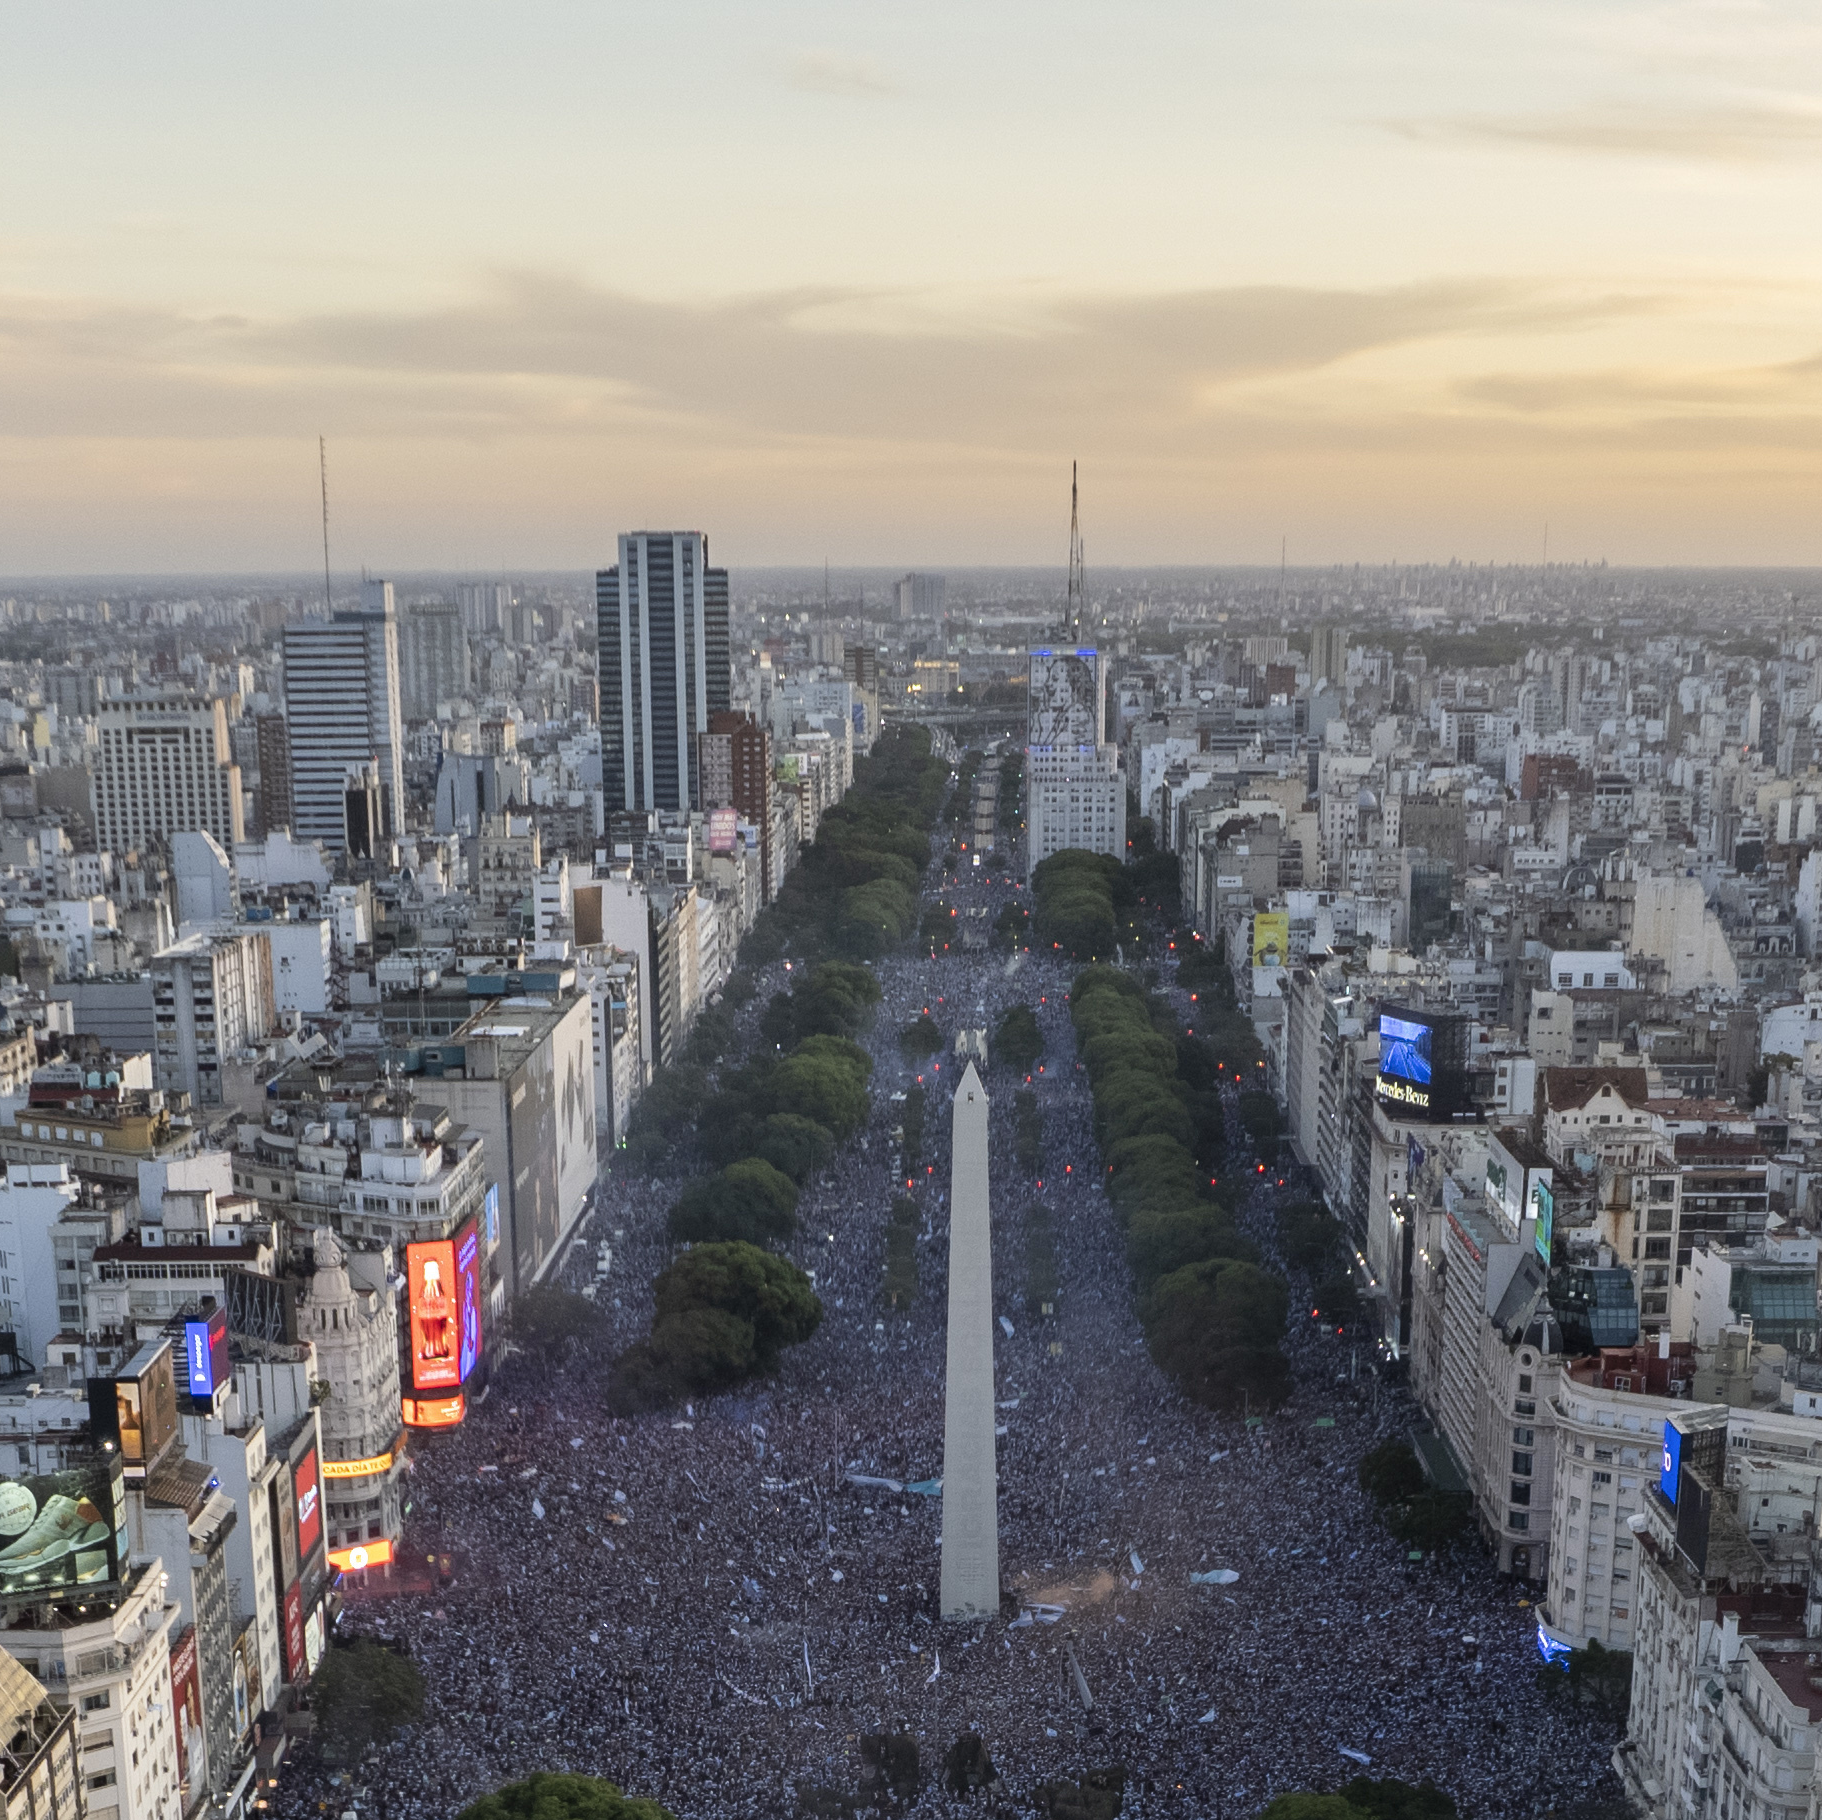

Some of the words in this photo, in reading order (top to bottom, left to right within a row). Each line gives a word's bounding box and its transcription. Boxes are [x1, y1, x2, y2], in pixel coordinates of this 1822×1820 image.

[1375, 1075, 1430, 1107] Mercedes-Benz
[322, 1466, 350, 1474] CADA
[352, 1461, 368, 1473] DÍA
[369, 1462, 379, 1470] TE
